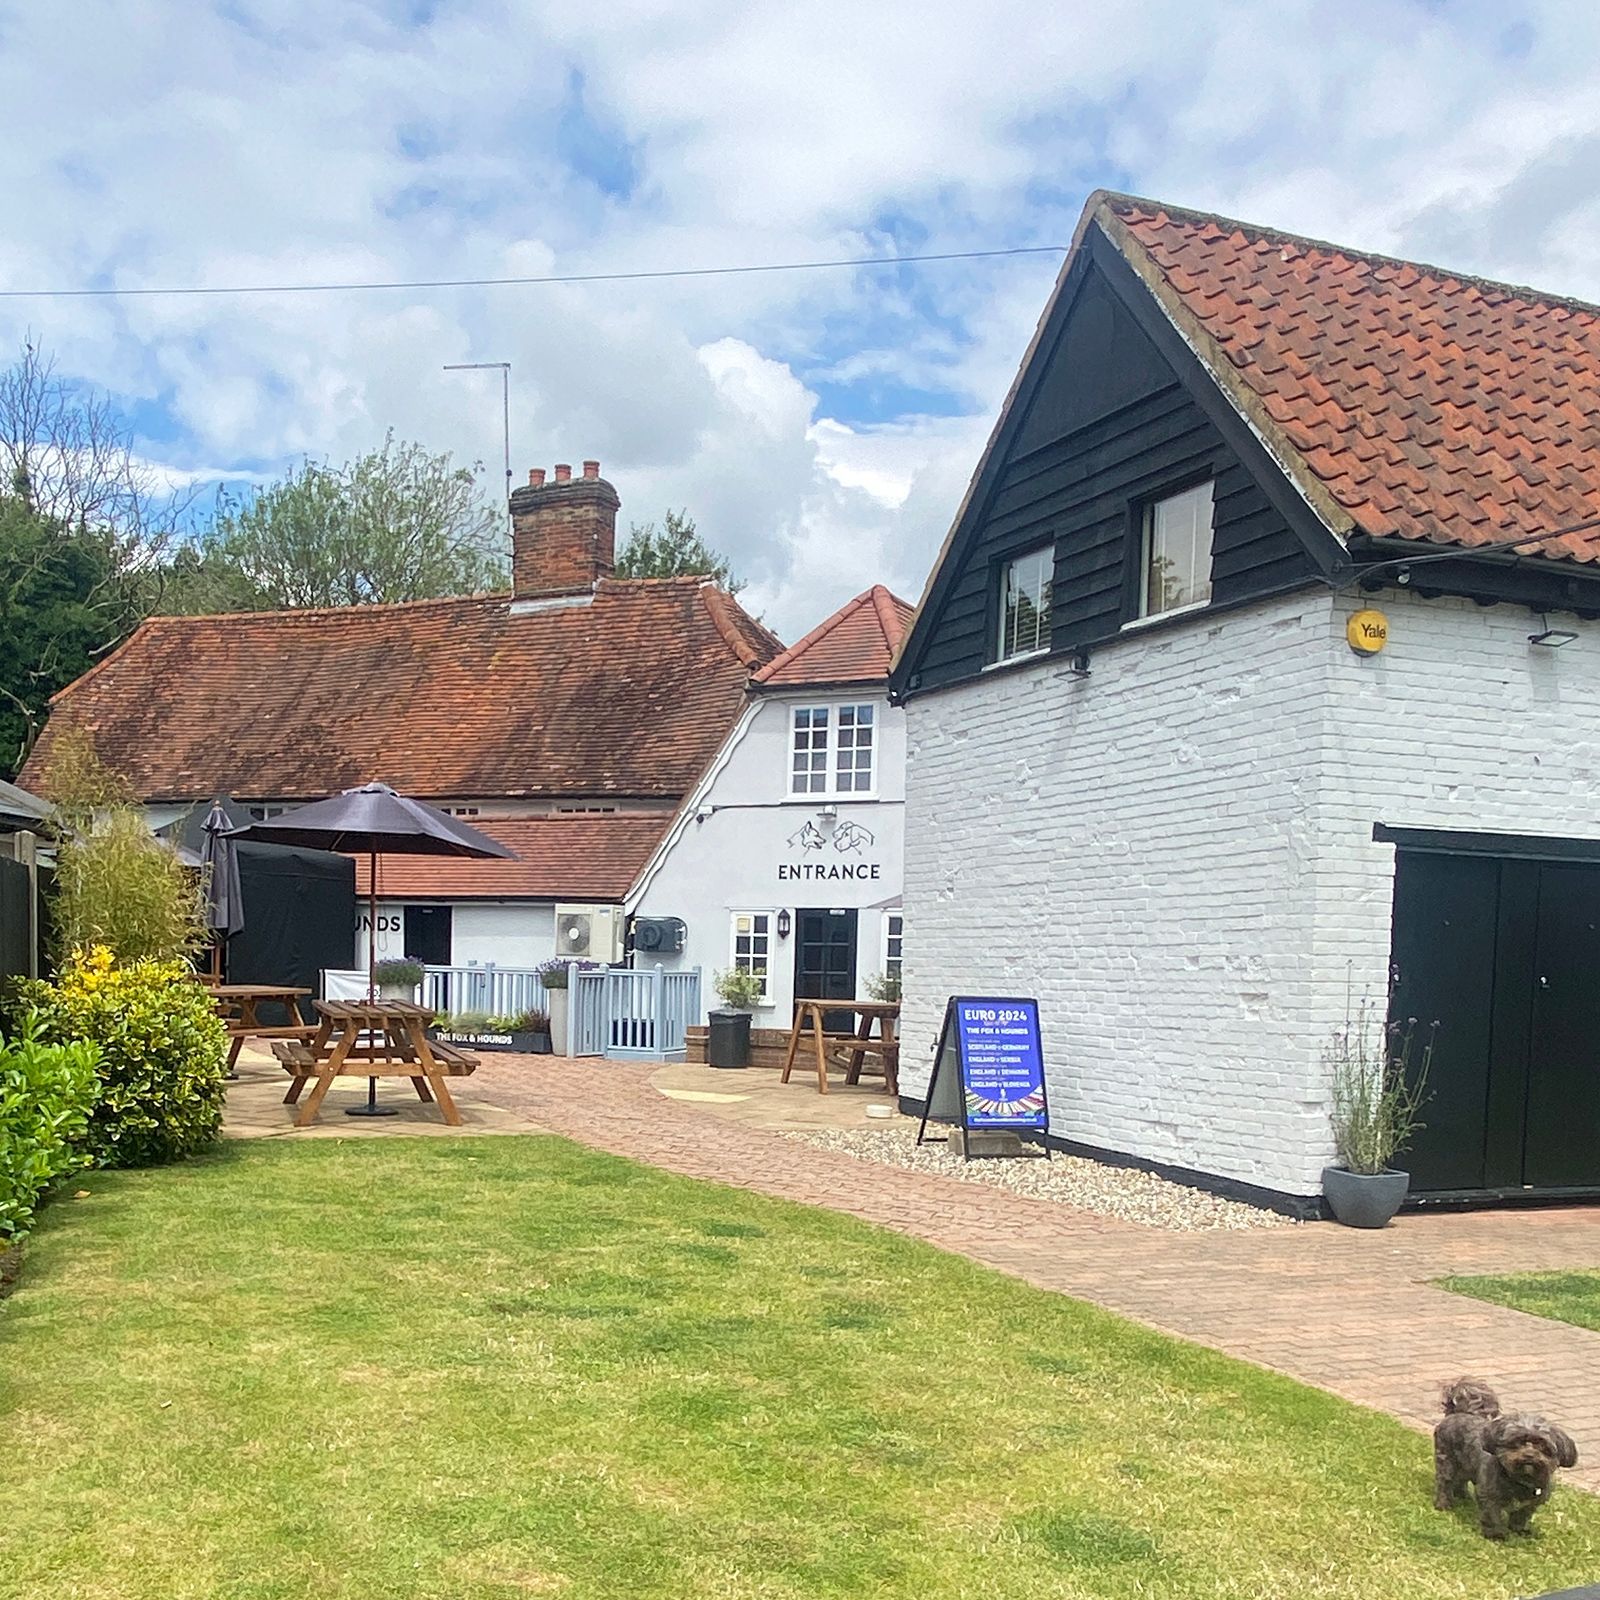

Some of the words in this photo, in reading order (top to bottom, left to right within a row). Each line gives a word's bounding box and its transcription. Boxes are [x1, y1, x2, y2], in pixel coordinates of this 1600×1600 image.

[1361, 623, 1387, 639] Yale
[778, 864, 880, 880] ENTRANCE
[964, 1009, 996, 1021] EURO
[998, 1010, 1028, 1021] 2024
[436, 1032, 451, 1041] THE
[452, 1033, 468, 1042] FOX
[469, 1034, 476, 1043] &
[477, 1034, 513, 1045] HOUNDS
